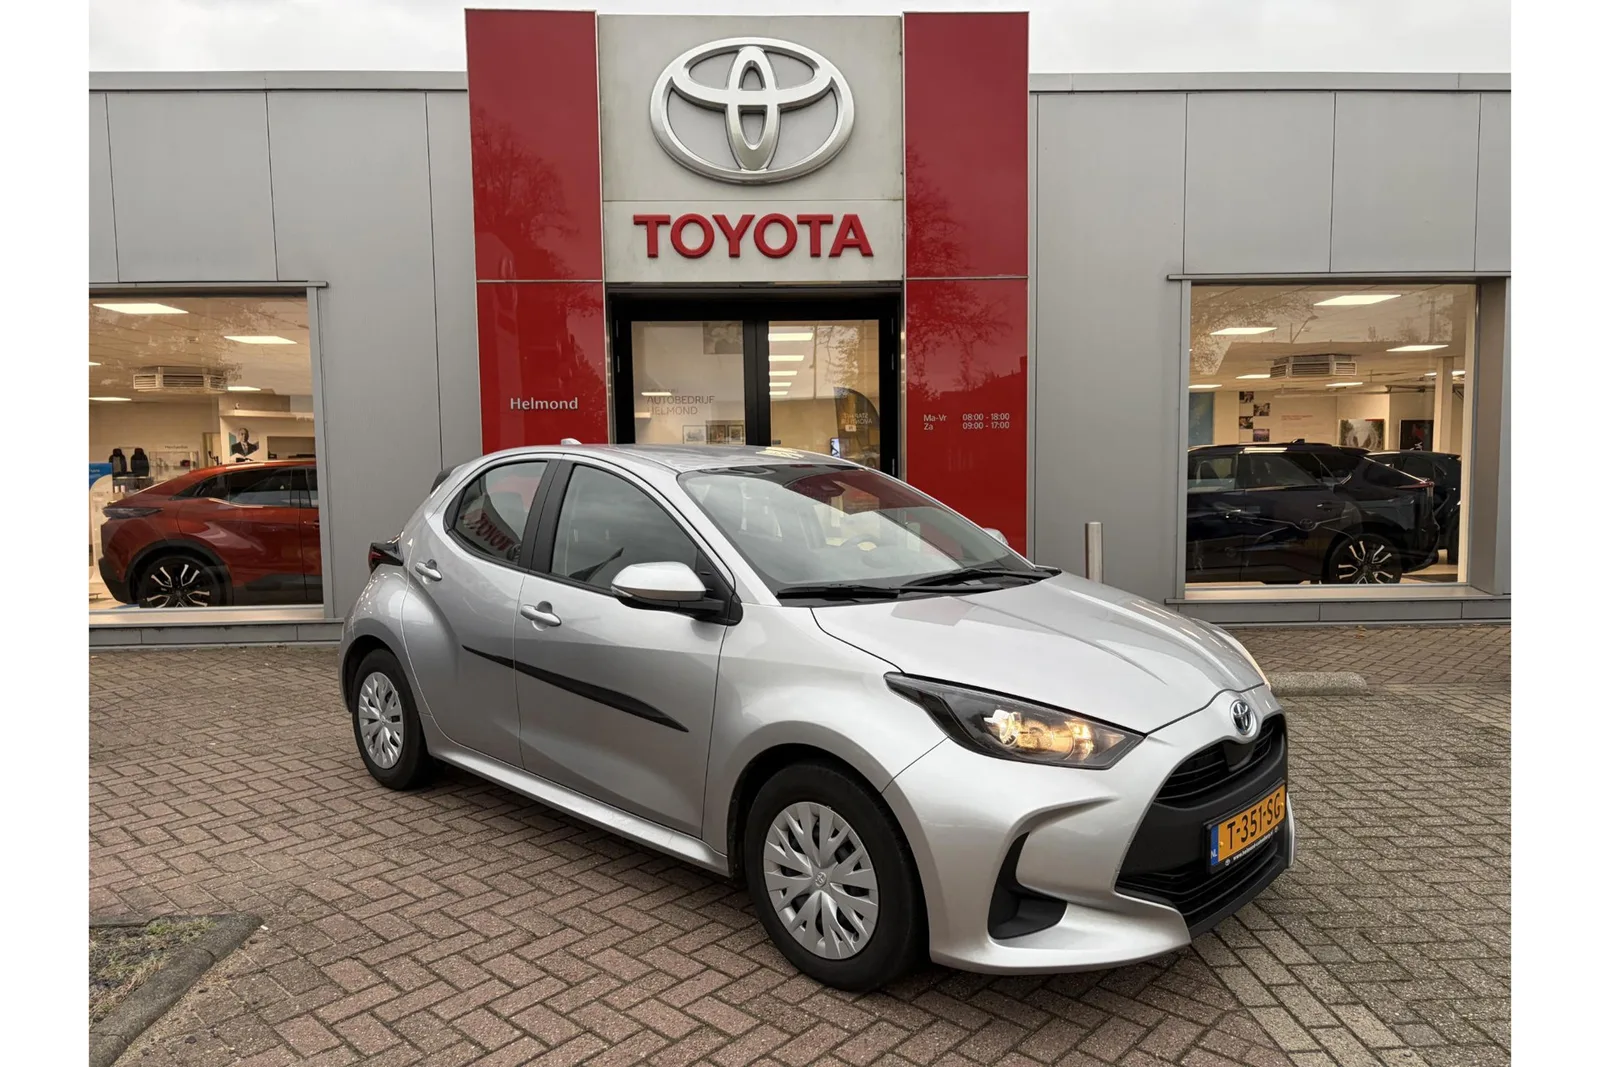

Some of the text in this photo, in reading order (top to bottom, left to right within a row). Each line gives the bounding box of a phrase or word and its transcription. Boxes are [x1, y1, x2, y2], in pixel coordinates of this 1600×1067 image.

[633, 213, 874, 259] TOYOTA
[510, 396, 578, 410] Helmond
[647, 395, 715, 405] AUTOBEDRIJF
[647, 406, 698, 416] HELMOND
[962, 413, 984, 421] 08:00
[923, 422, 934, 430] Za
[990, 421, 1010, 429] 17:00
[1227, 792, 1280, 850] T-351-SG
[1211, 848, 1218, 859] NL
